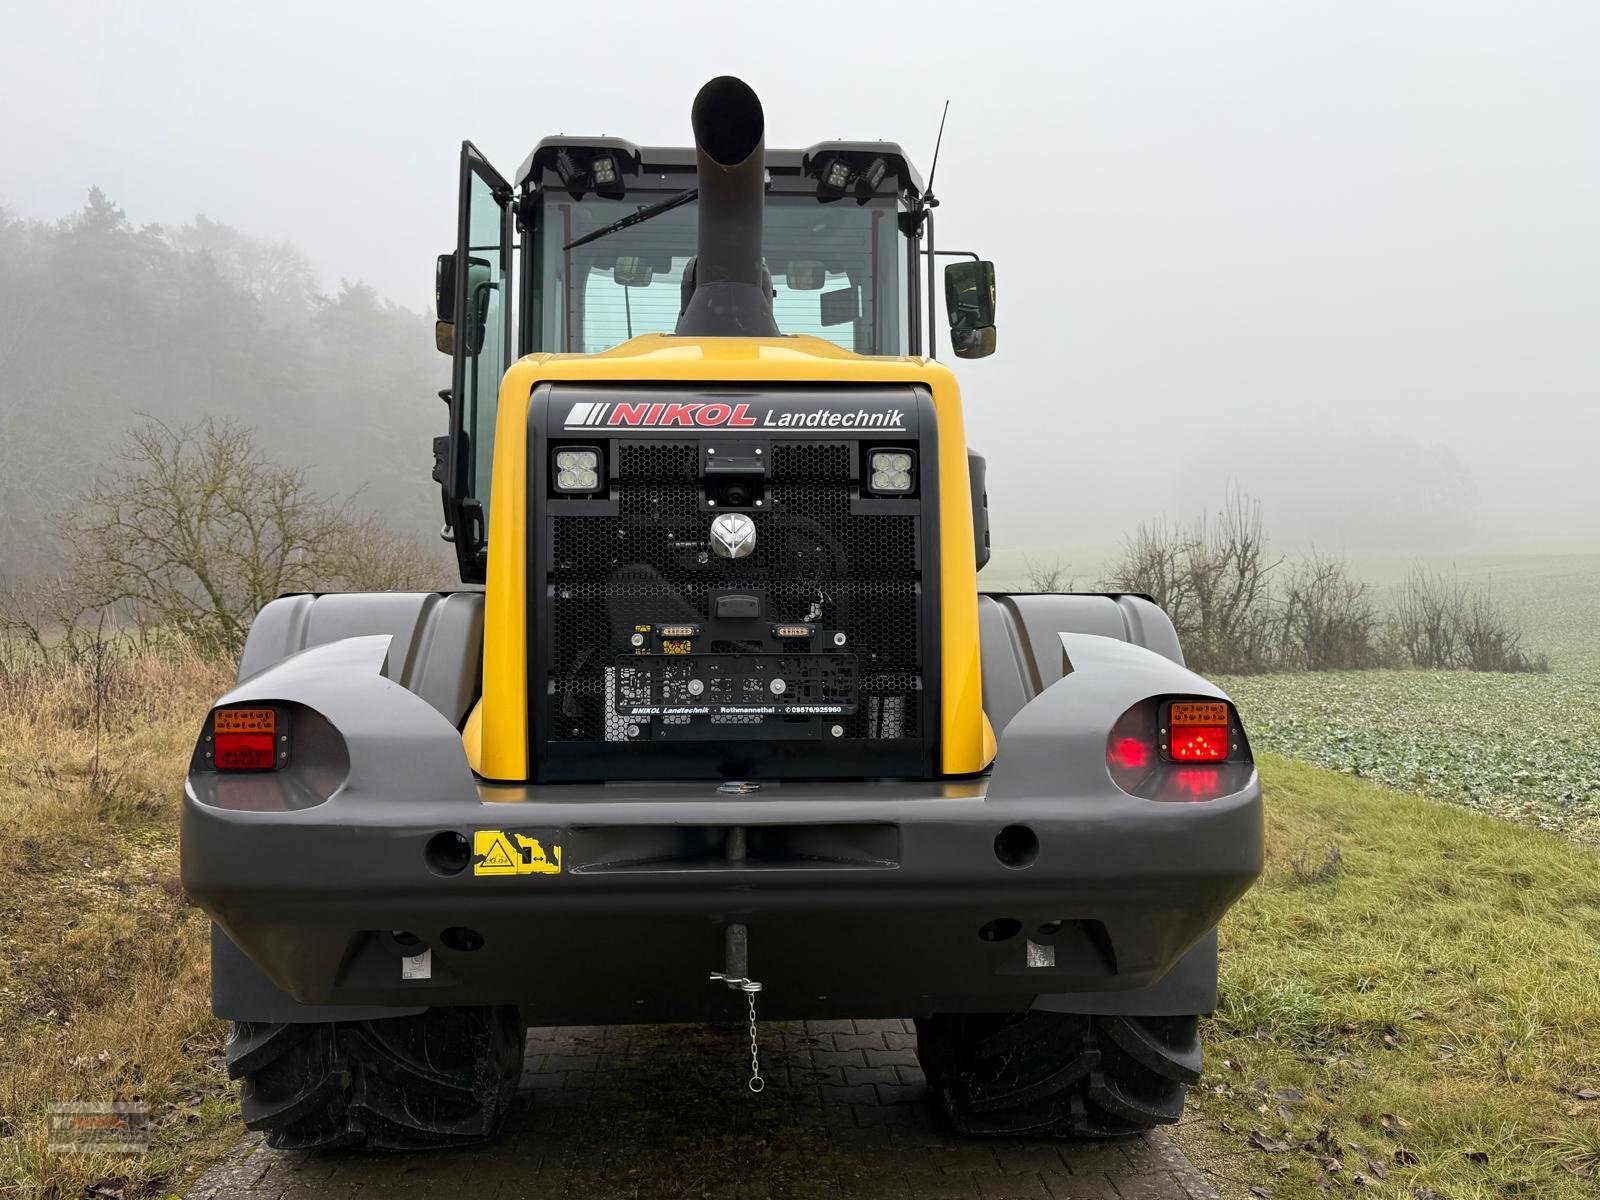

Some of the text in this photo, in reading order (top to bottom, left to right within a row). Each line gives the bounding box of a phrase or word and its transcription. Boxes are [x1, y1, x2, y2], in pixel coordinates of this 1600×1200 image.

[608, 402, 905, 427] NIKOL Landtechnik
[662, 706, 710, 714] Landtechnik
[720, 706, 775, 714] Rothmannsthal
